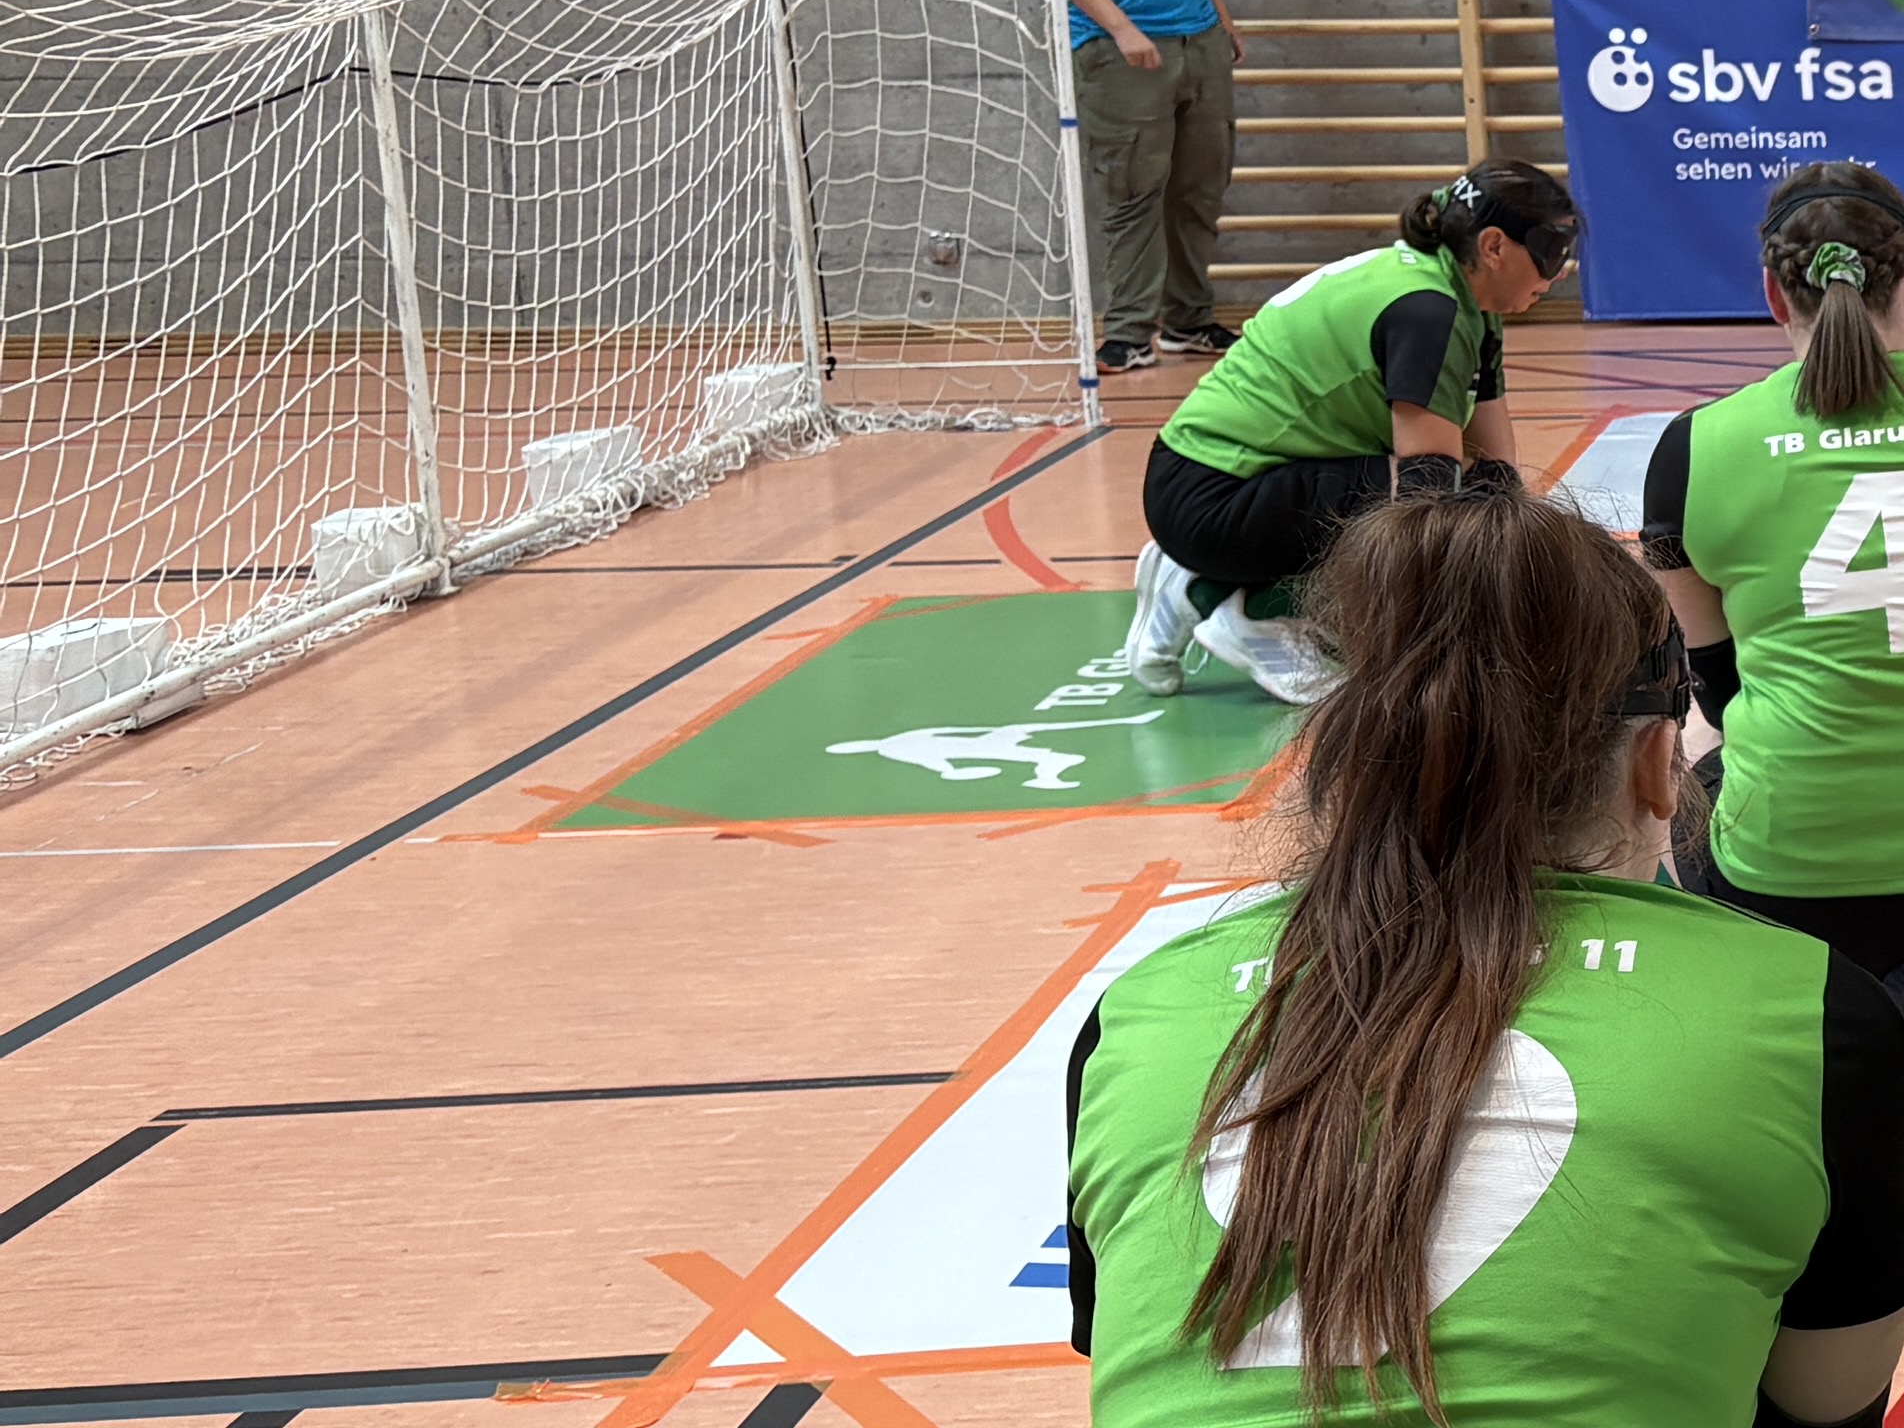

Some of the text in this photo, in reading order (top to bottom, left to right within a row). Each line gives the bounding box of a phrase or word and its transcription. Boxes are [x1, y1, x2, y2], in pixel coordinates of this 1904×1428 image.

[1667, 47, 1894, 103] sbv fsa
[1672, 126, 1828, 151] Gemeinsam
[1675, 158, 1752, 181] sehen
[1760, 156, 1801, 180] wir
[1764, 433, 1805, 457] TB
[1033, 682, 1125, 711] TB
[1580, 939, 1639, 972] 11
